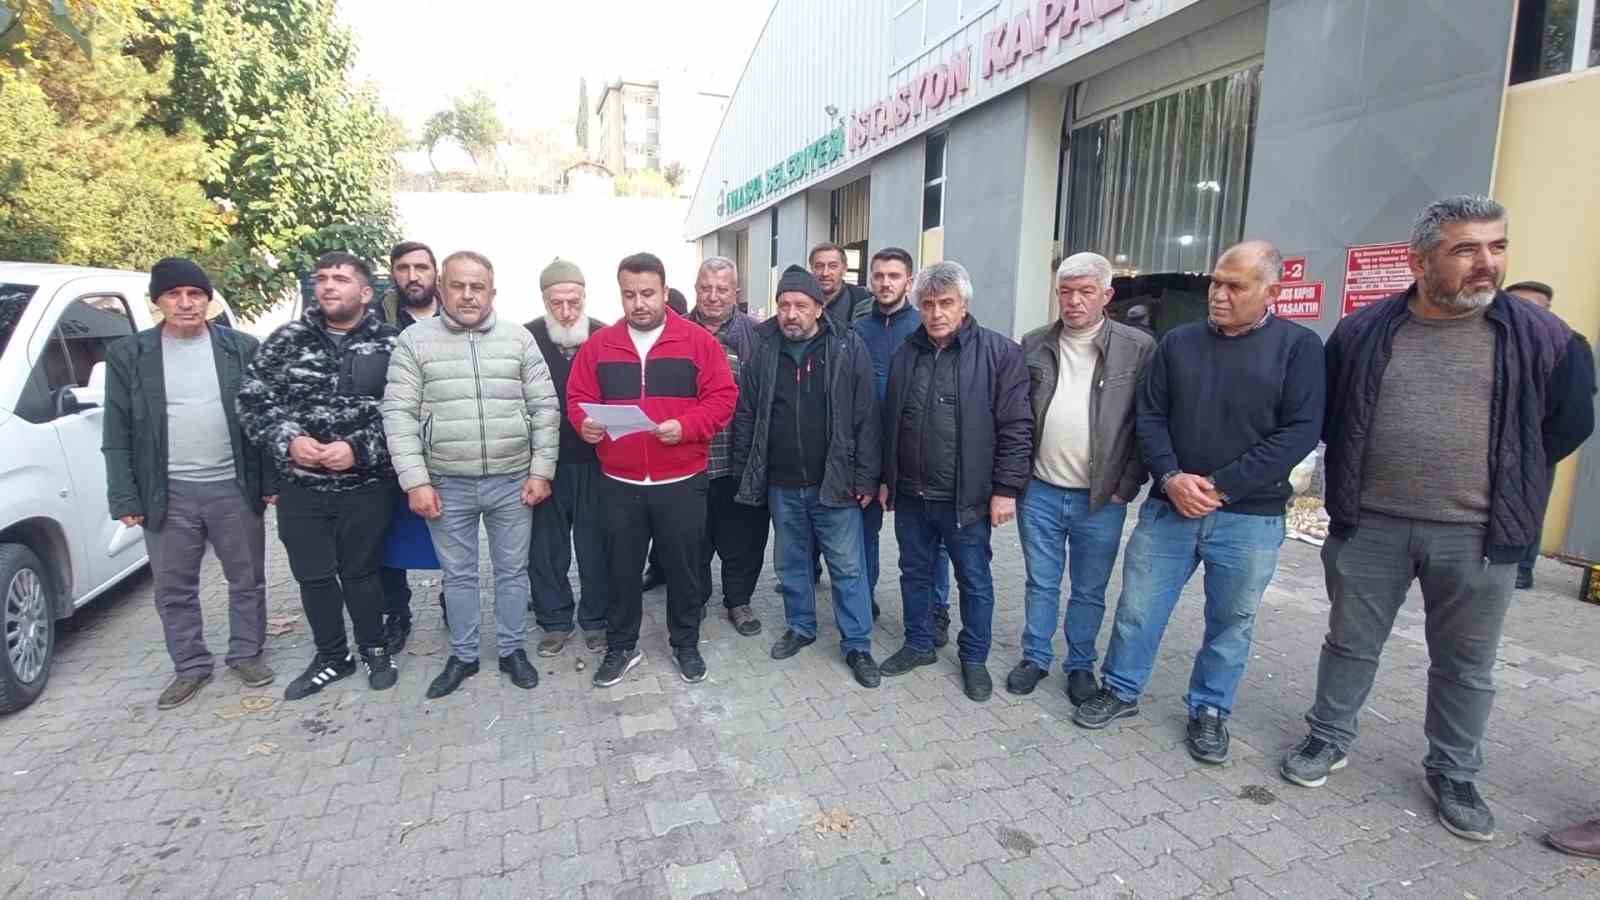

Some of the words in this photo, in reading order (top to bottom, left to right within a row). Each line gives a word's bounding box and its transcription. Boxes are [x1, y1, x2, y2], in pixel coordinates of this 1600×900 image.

[848, 45, 971, 152] İSTASYON
[983, 0, 1138, 80] KAPAL
[1277, 302, 1319, 314] YASAKTIR
